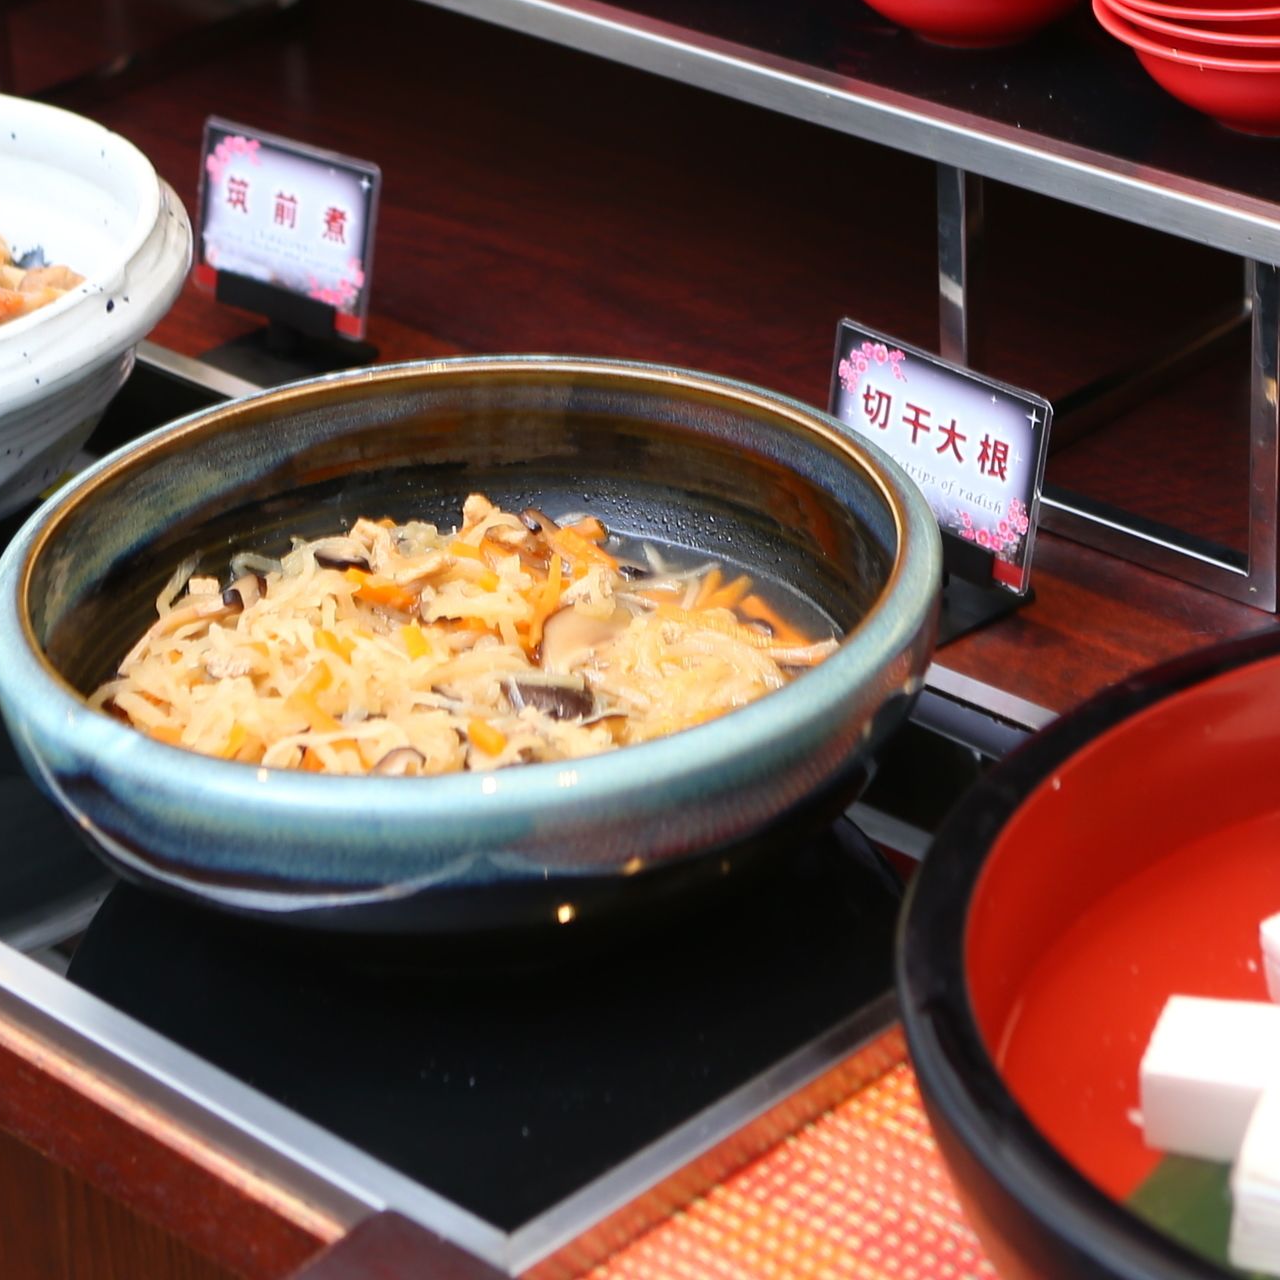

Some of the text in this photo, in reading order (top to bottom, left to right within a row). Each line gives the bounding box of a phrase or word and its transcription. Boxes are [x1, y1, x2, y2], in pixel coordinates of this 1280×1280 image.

[226, 175, 347, 245] 筑前煮
[862, 384, 1009, 483] 切干大根
[941, 479, 956, 496] of
[959, 486, 1002, 515] radish
